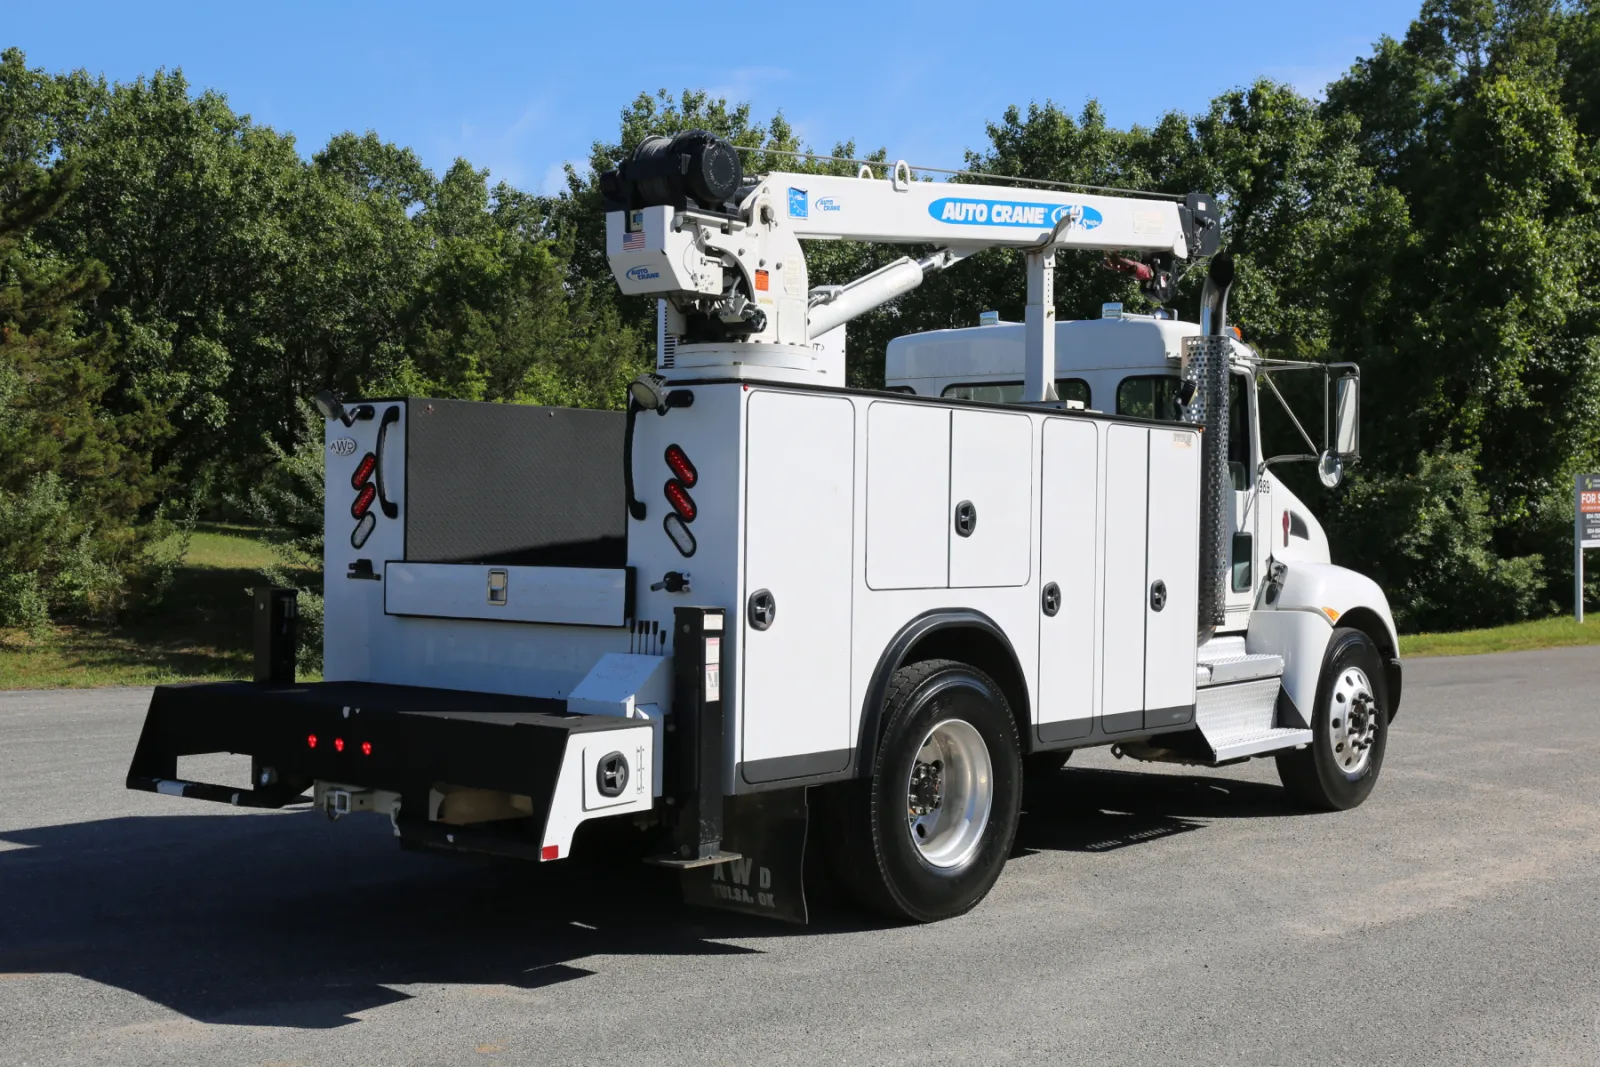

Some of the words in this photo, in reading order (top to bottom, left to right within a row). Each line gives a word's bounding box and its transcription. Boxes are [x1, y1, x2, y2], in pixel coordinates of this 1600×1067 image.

[941, 202, 988, 222] AUTO
[991, 204, 1045, 224] CRANE
[637, 272, 660, 280] CRANE
[331, 440, 354, 451] AWD
[1581, 493, 1596, 504] FOR
